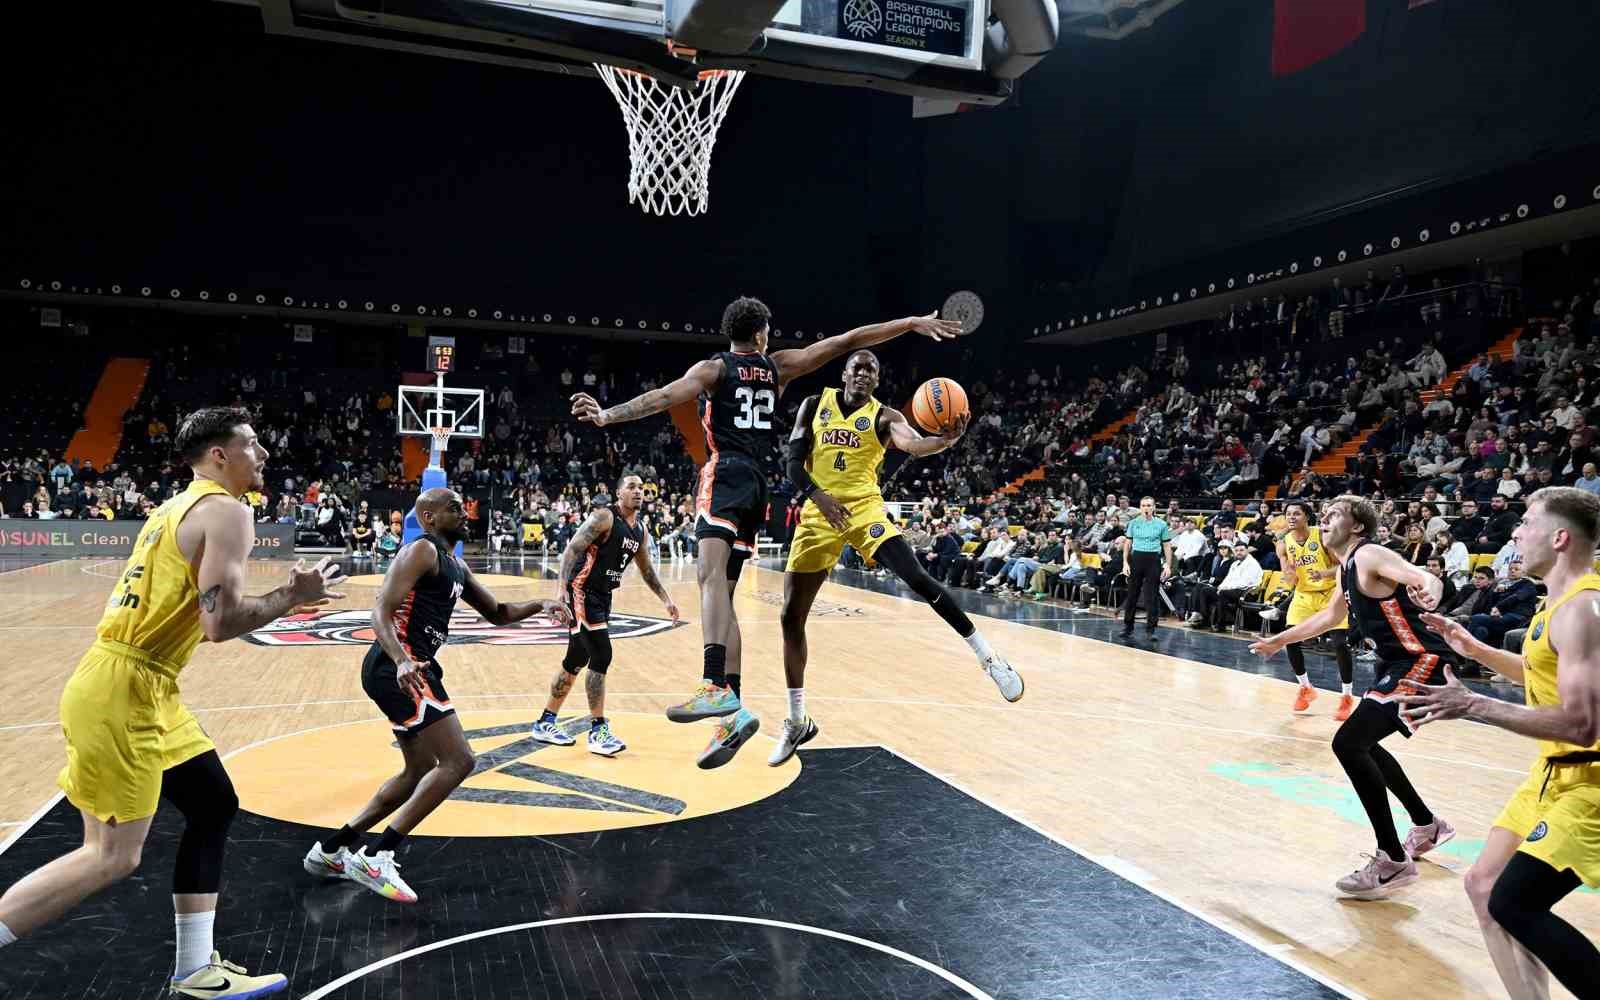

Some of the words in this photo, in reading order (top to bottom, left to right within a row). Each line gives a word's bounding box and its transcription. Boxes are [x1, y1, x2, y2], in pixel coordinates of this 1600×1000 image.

[886, 0, 953, 20] BASKETBALL
[885, 10, 961, 32] CHAMPIONS
[885, 22, 927, 37] LEAGUE
[885, 34, 918, 46] SEASON
[438, 356, 450, 369] 12
[733, 386, 776, 430] 32
[821, 428, 860, 449] MSK
[833, 451, 847, 472] 4
[11, 531, 75, 546] SUNEL
[81, 532, 131, 546] Clean
[621, 537, 641, 553] MSB
